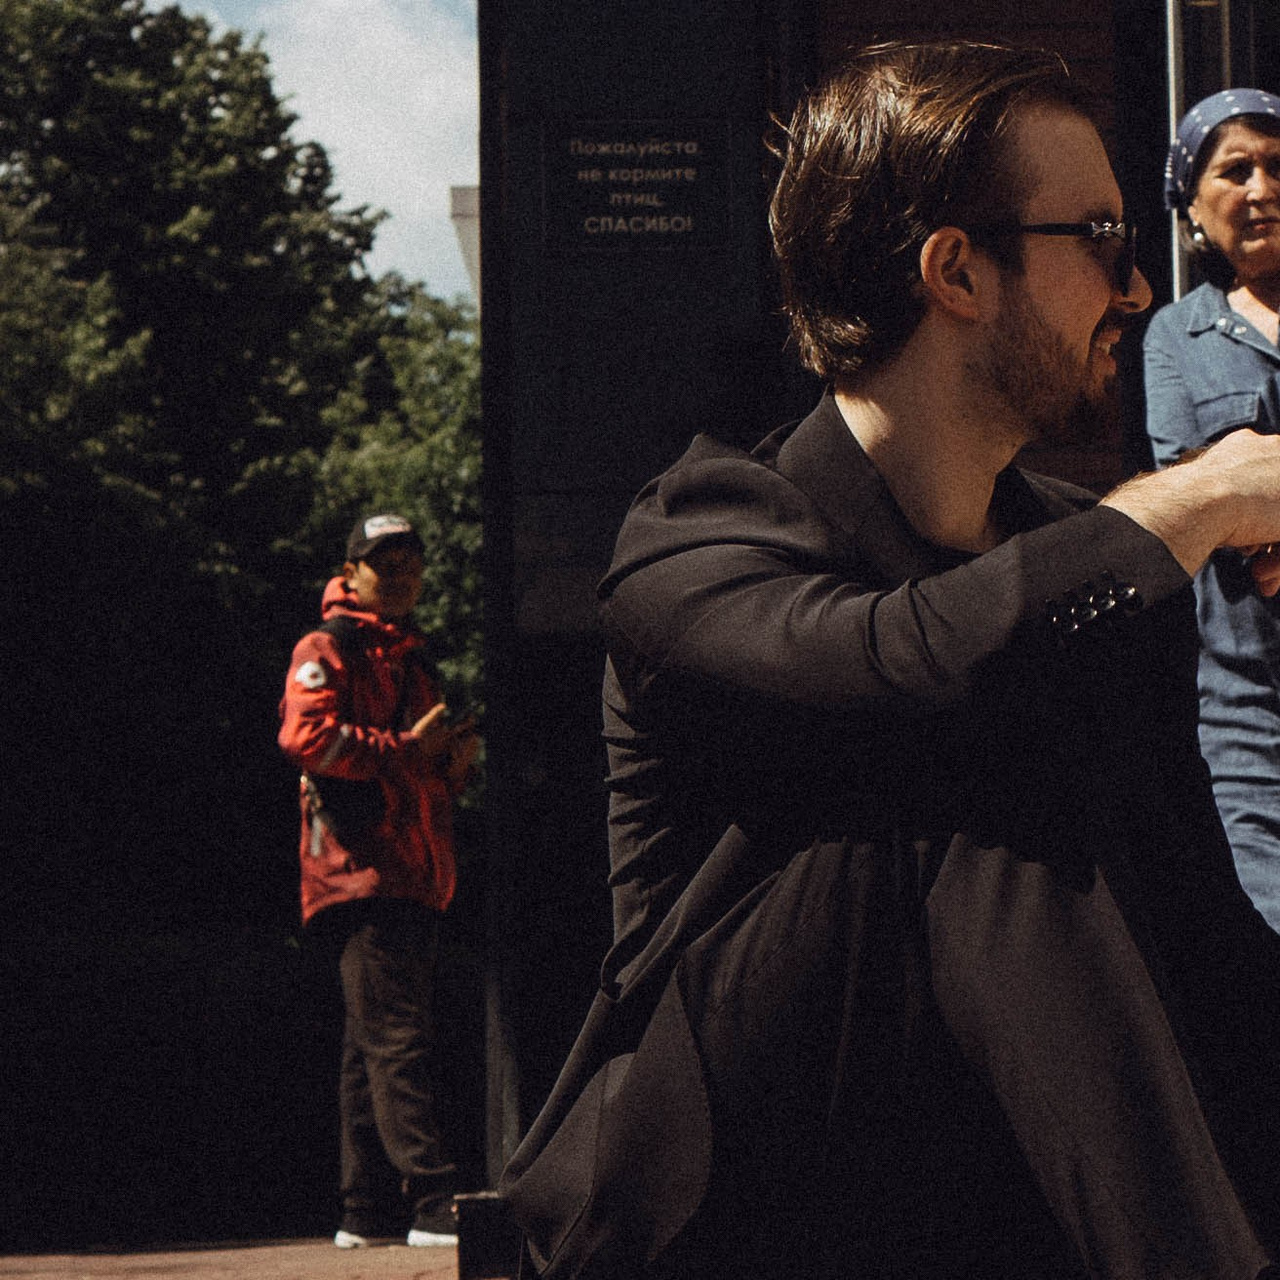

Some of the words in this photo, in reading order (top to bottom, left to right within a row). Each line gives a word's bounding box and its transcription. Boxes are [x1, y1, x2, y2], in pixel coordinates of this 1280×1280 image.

[577, 167, 602, 182] не
[607, 167, 698, 186] кормите
[583, 215, 693, 235] СПАСИБО!
